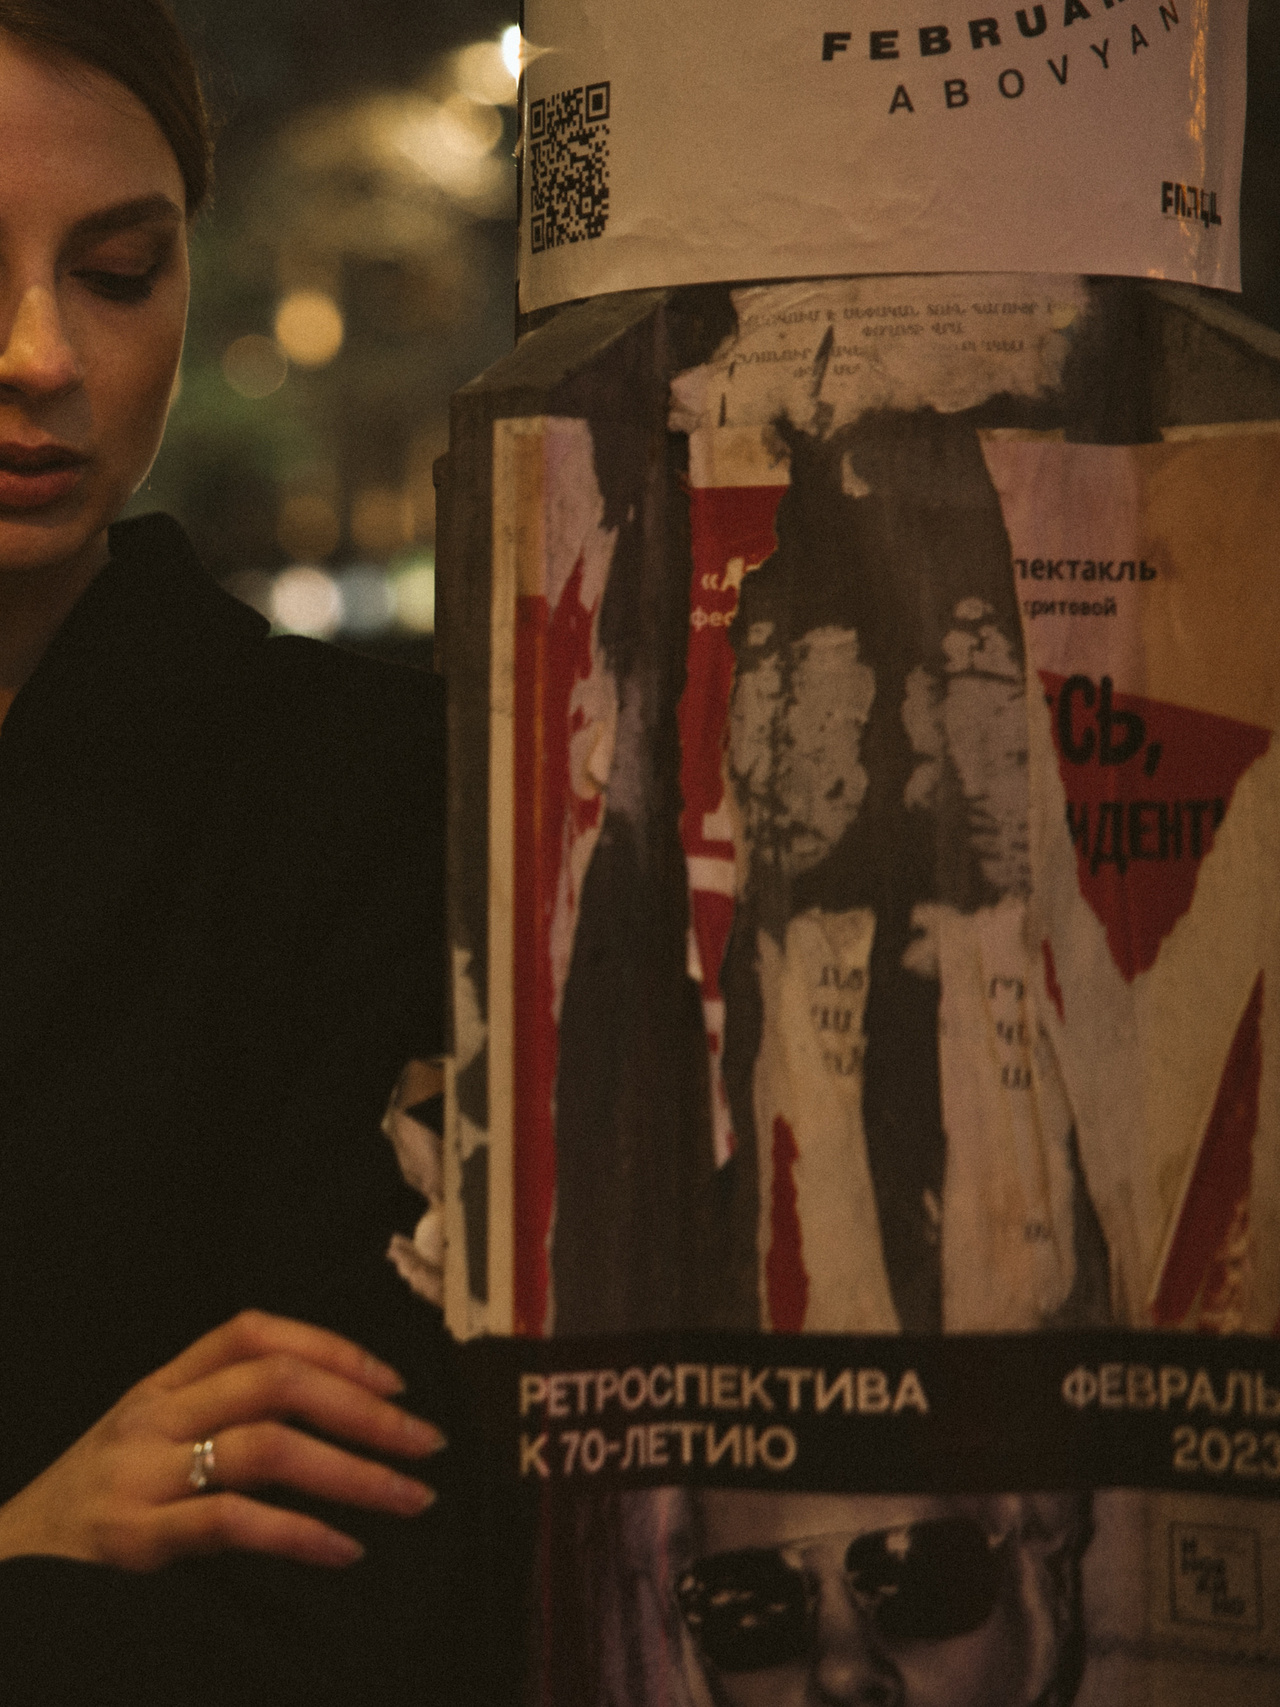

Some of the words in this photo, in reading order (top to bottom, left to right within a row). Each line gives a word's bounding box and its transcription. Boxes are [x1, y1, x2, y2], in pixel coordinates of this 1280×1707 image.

[822, 0, 1124, 61] FEBRUA
[888, 0, 1180, 114] ABOVYAN
[520, 1364, 929, 1418] РЕТРОСПЕКТИВА
[1061, 1363, 1280, 1416] ФЕВРАЛЬ
[521, 1434, 549, 1476] К
[561, 1427, 798, 1473] 70-ЛЕТИЮ
